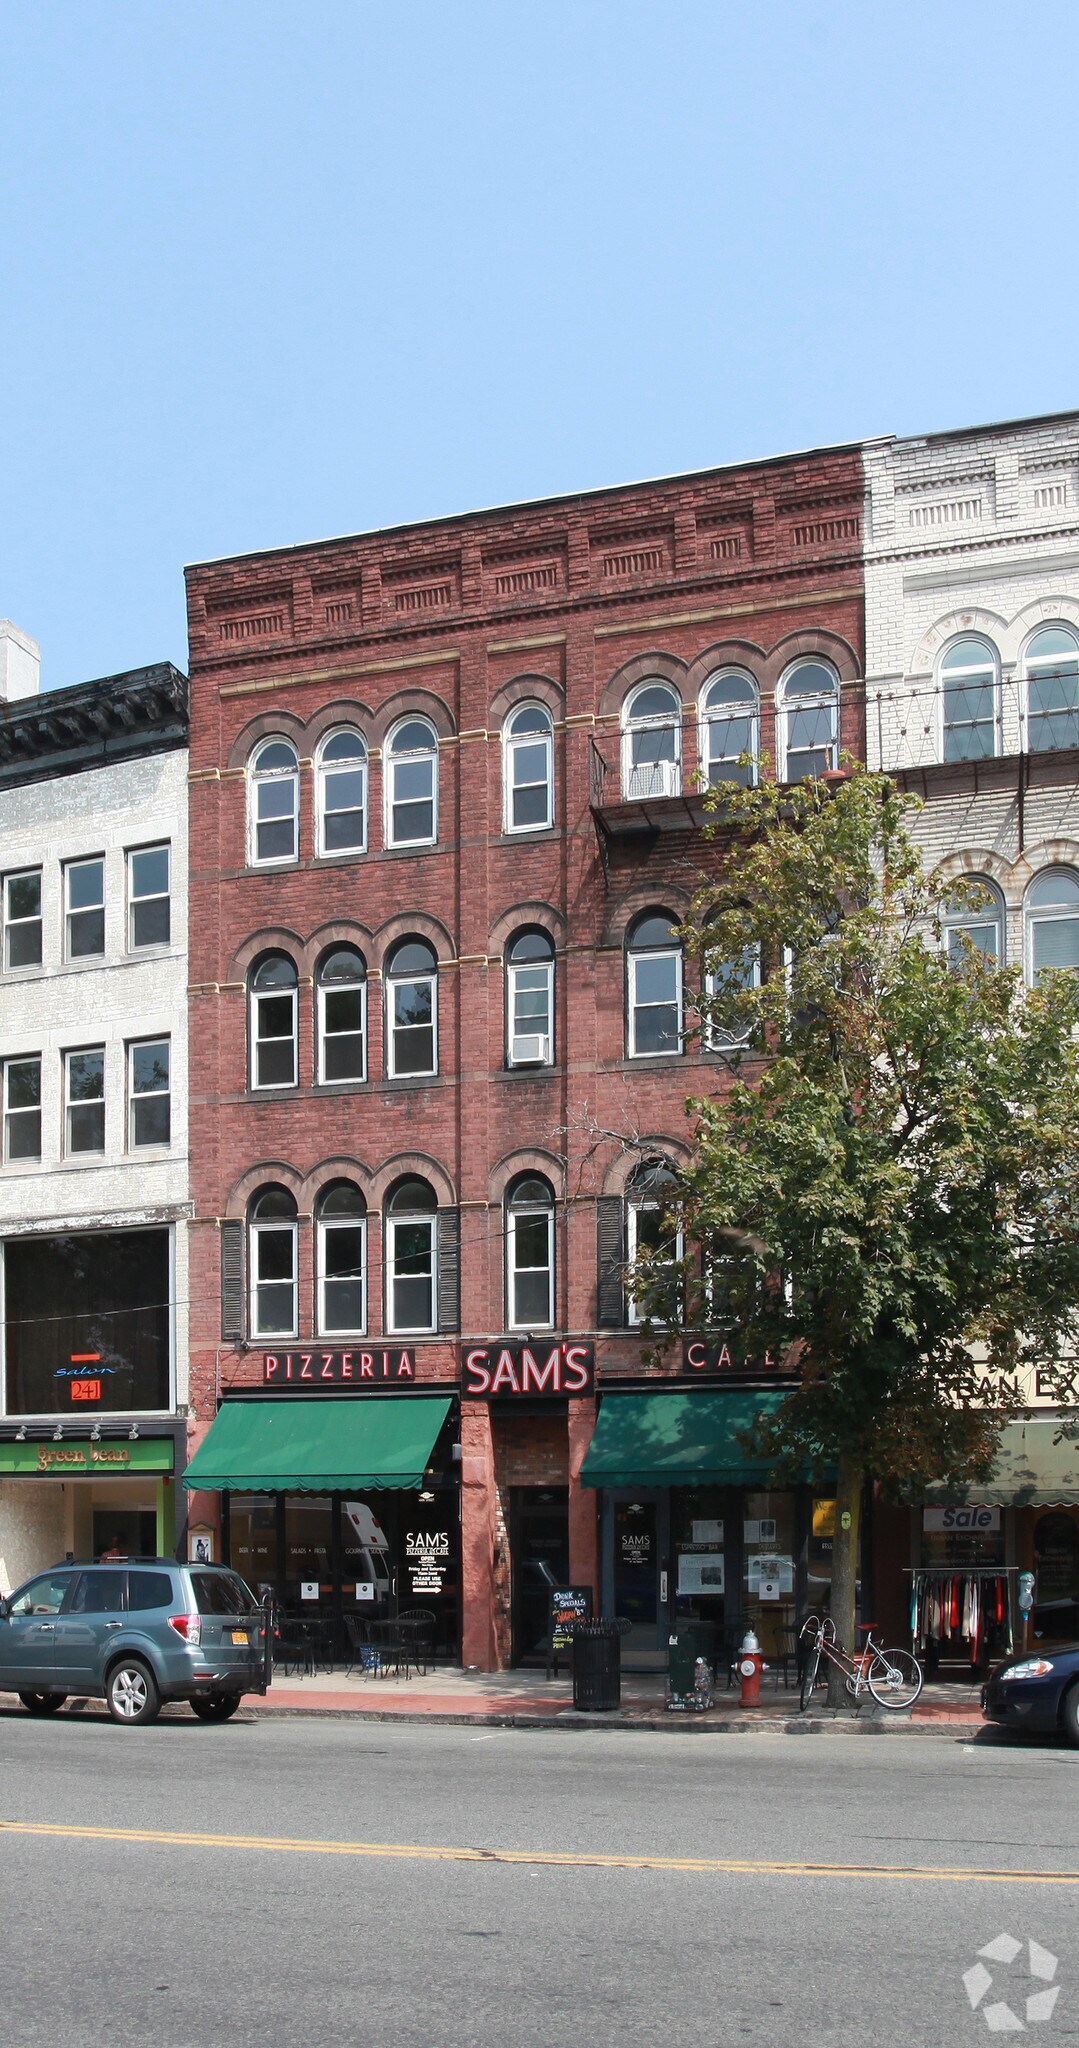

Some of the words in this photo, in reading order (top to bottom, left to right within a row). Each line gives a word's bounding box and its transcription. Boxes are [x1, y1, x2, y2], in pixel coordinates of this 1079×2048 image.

[265, 1351, 413, 1380] PIZZERIA
[466, 1343, 590, 1393] SAM'S
[72, 1381, 100, 1399] 241
[37, 1449, 87, 1471] green
[89, 1442, 129, 1462] bean
[942, 1507, 992, 1528] Sale
